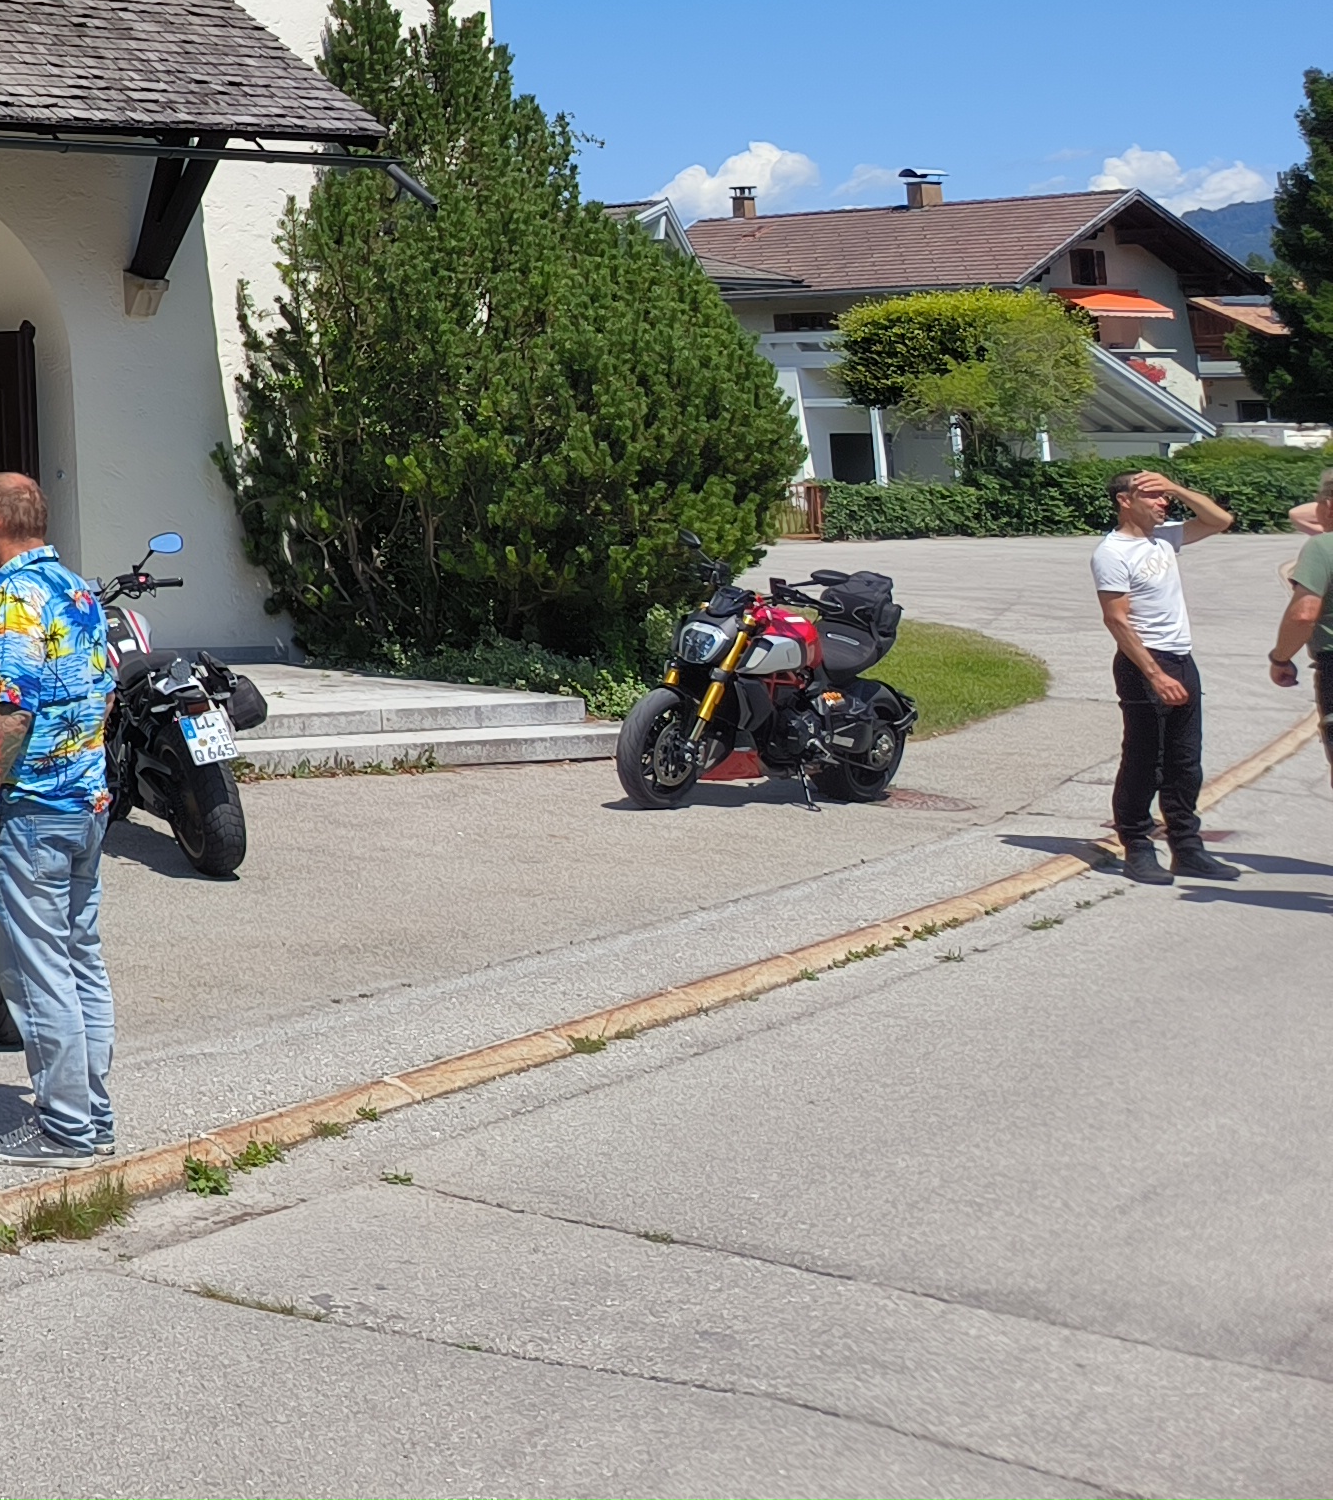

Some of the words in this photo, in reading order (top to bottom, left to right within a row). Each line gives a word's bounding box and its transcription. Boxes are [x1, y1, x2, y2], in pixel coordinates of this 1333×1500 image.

[193, 715, 215, 730] LL
[194, 749, 206, 762] Q
[207, 742, 235, 760] 645
